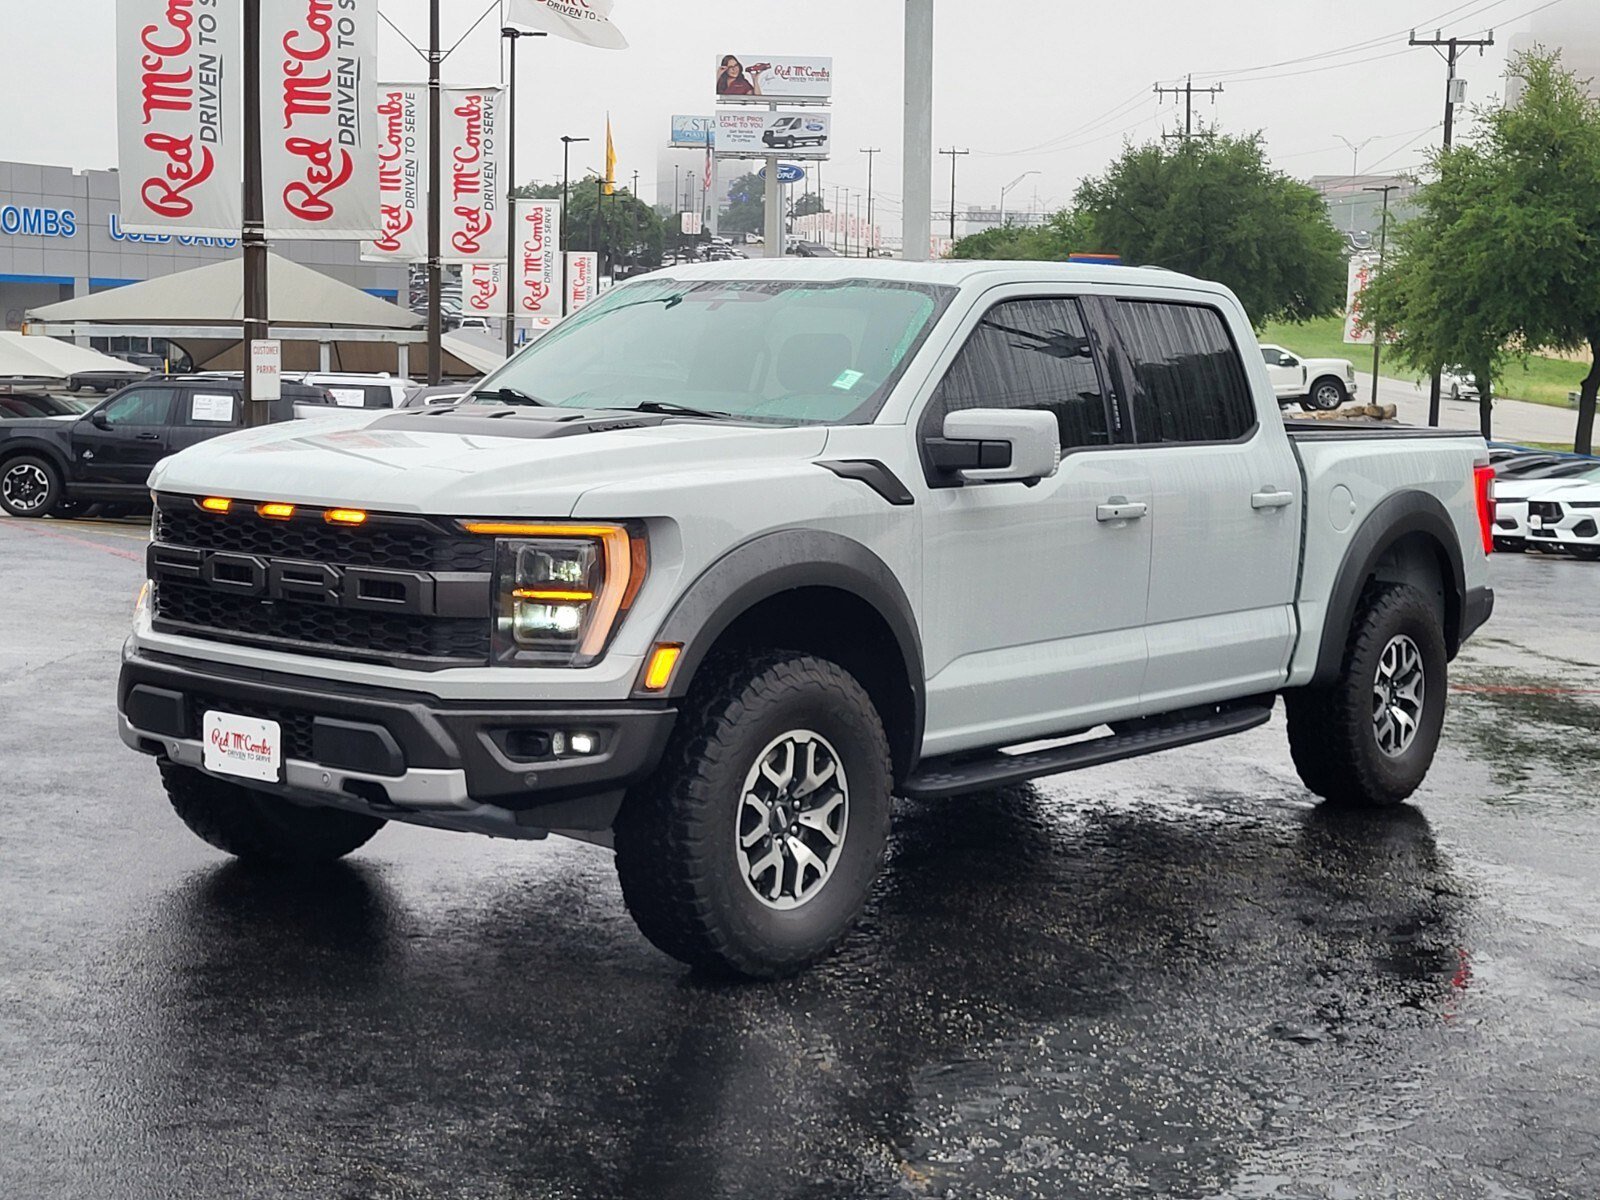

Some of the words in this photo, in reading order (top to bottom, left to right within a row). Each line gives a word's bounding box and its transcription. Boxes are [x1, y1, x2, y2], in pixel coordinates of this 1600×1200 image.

[546, 1, 582, 17] DRIVEN
[584, 11, 596, 20] TO
[198, 14, 217, 45] TO
[337, 17, 355, 48] TO
[774, 65, 791, 79] Red
[792, 66, 829, 78] McCombs
[198, 54, 217, 143] DRIVEN
[337, 57, 355, 146] DRIVEN
[405, 92, 415, 133] SERVE
[484, 96, 494, 135] SERVE
[376, 92, 403, 191] McCombs
[405, 137, 415, 155] TO
[453, 95, 481, 202] McCombs
[484, 138, 494, 156] TO
[141, 133, 214, 217] Red
[283, 138, 353, 221] Red
[405, 159, 415, 209] DRIVEN
[484, 161, 494, 211] DRIVEN
[1, 206, 76, 237] OMBS
[373, 204, 413, 251] Red
[452, 206, 492, 254] Red
[544, 206, 552, 234] SERVE
[524, 207, 543, 277] McCombs
[544, 237, 552, 249] TO
[544, 251, 552, 284] DRIVEN
[470, 279, 497, 309] Red
[522, 280, 549, 311] Red
[253, 346, 278, 354] CUSTOMER
[256, 365, 277, 374] PARKING
[147, 541, 431, 615] FORD
[211, 728, 229, 753] Red
[231, 732, 271, 755] McCombs
[227, 750, 246, 759] DRIVEN
